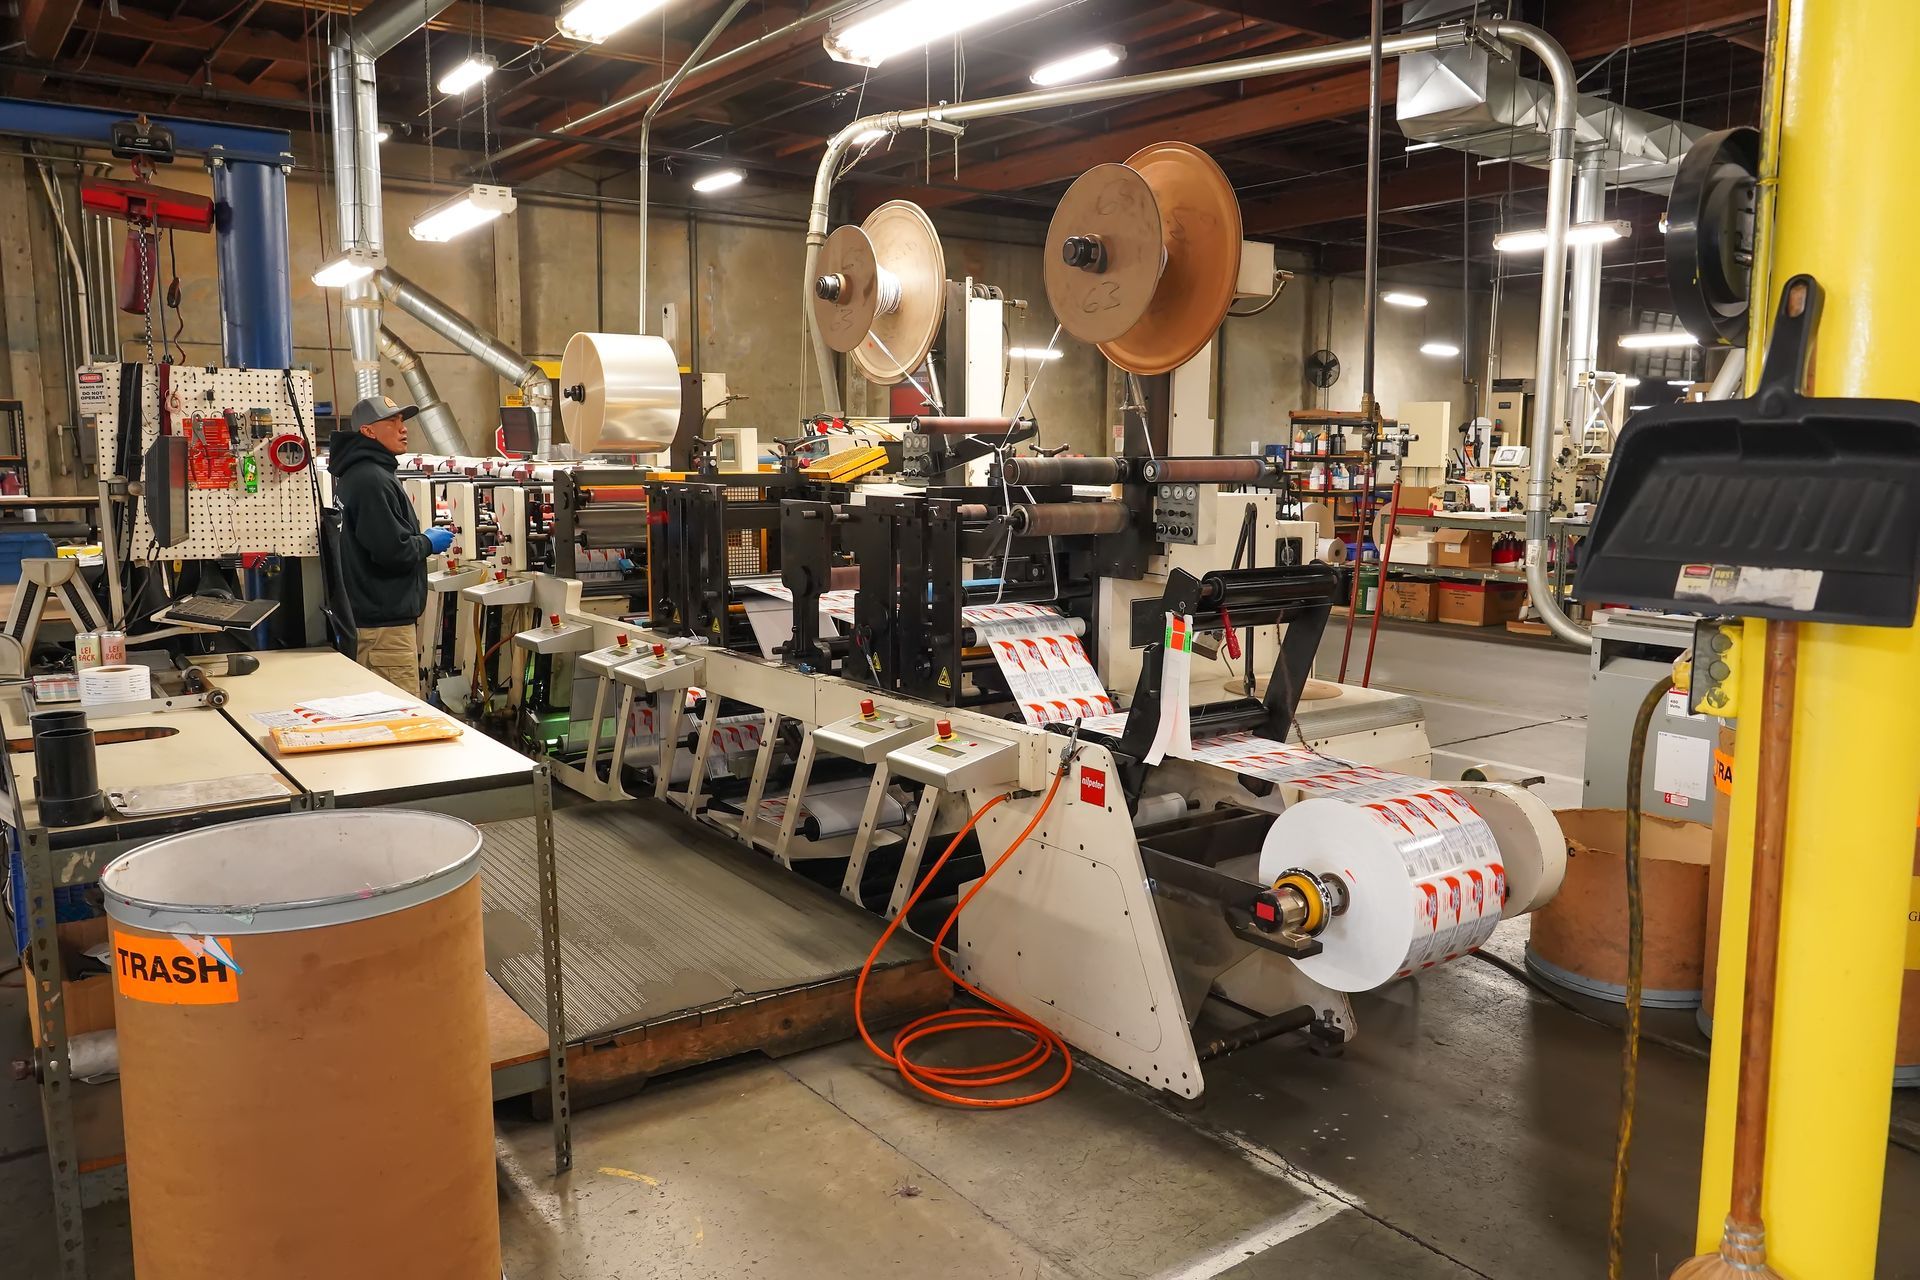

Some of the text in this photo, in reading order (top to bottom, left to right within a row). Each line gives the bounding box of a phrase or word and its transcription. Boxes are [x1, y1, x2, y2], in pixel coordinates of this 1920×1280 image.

[80, 646, 91, 654] LEI
[108, 645, 120, 653] LEI
[117, 947, 228, 985] TRASH
